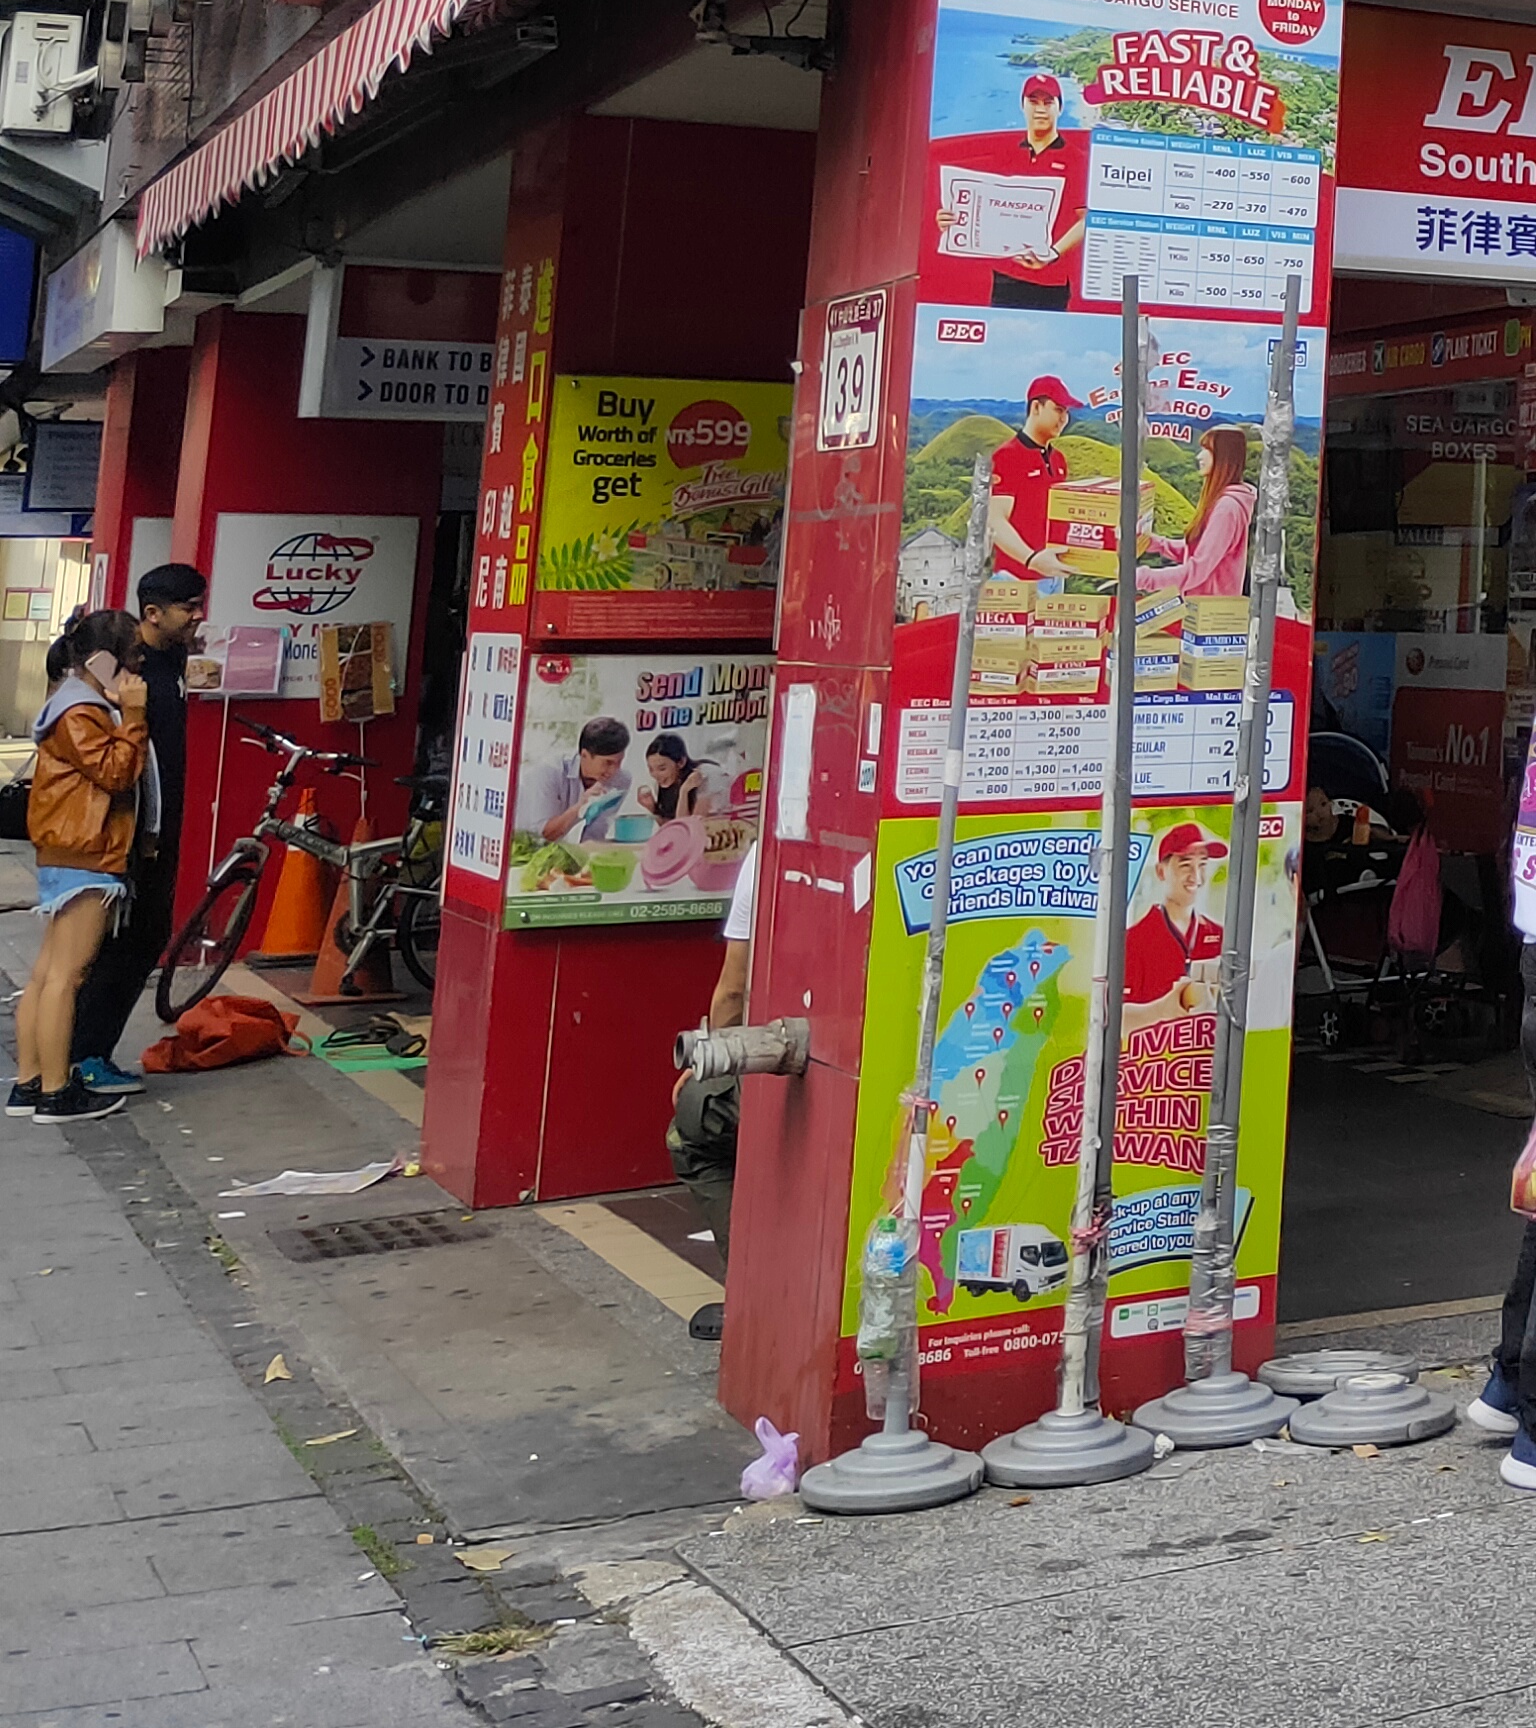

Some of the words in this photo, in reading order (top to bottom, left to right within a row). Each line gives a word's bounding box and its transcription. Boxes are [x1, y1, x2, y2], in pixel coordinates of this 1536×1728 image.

[1287, 11, 1300, 23] to
[1270, 21, 1318, 39] FRIDAY
[1116, 34, 1221, 68] FAST
[1225, 36, 1257, 76] &
[1100, 68, 1276, 126] RELIABLE
[1101, 163, 1152, 184] Taipei
[941, 323, 984, 340] EEC
[382, 348, 440, 371] BANK
[448, 349, 475, 370] TO
[379, 379, 435, 405] DOOR
[445, 382, 470, 405] TO
[835, 354, 865, 423] 39
[597, 390, 656, 425] Buy
[577, 425, 633, 444] Worth
[638, 425, 658, 444] of
[1405, 414, 1445, 434] SEA
[1450, 414, 1517, 435] CARGO
[572, 449, 657, 469] Groceries
[1431, 441, 1498, 461] BOXES
[591, 472, 642, 505] get
[265, 561, 363, 587] Lucky
[634, 666, 702, 703] Send
[634, 706, 656, 731] to
[661, 703, 692, 728] the
[953, 847, 990, 869] can
[996, 837, 1038, 859] now
[1044, 834, 1091, 855] send
[950, 862, 1044, 895] packages
[1054, 861, 1075, 879] to
[1016, 888, 1034, 906] in
[629, 900, 723, 918] 02-2595-8686
[1154, 1193, 1169, 1210] at
[1173, 1191, 1199, 1211] any
